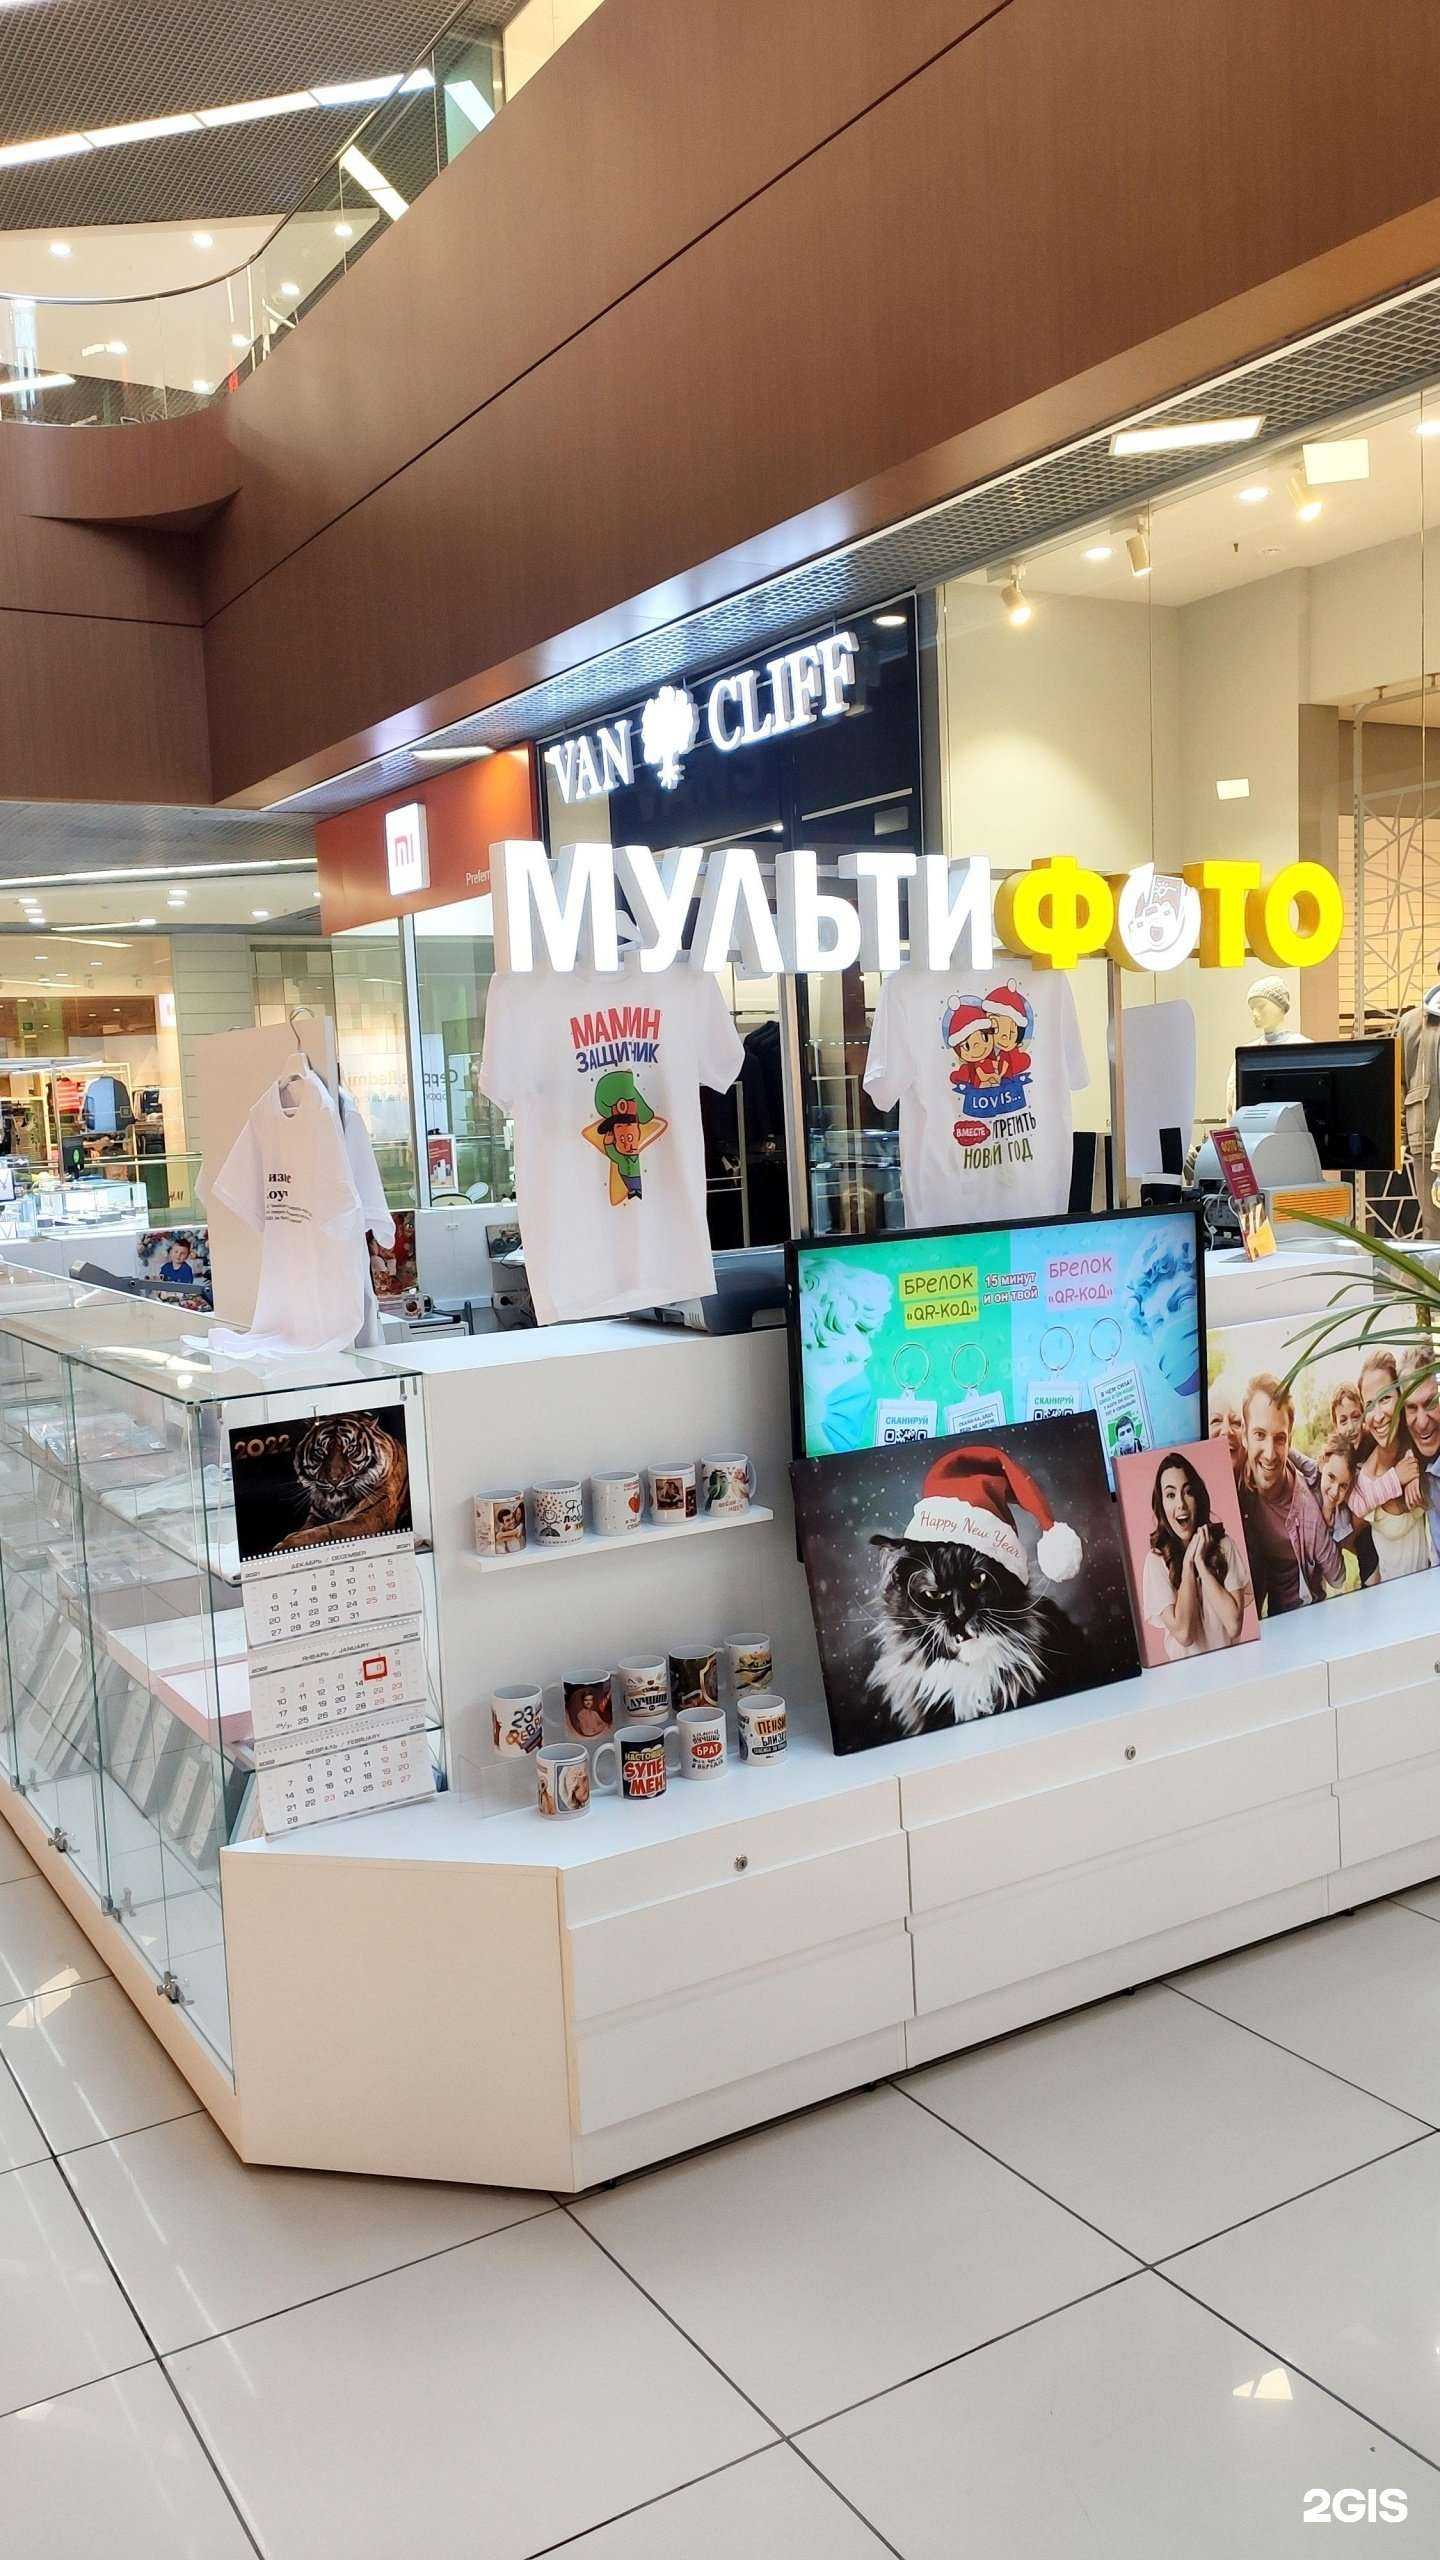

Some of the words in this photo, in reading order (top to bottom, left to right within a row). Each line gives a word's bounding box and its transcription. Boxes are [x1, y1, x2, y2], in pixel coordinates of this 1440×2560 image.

[545, 719, 635, 803] VAN
[708, 631, 860, 751] CLIFF
[570, 1006, 661, 1050] МАМИН
[972, 1096, 998, 1109] LOV
[956, 1127, 986, 1138] ВМЕСТЕ
[1007, 1137, 1033, 1163] ГОД
[985, 1276, 998, 1288] 15
[1000, 1272, 1037, 1288] минут
[983, 1294, 992, 1305] и
[994, 1292, 1009, 1303] он
[1010, 1288, 1039, 1302] твой
[1034, 1395, 1074, 1405] СКАНИРУЙ
[885, 1415, 929, 1426] СКАНИРУЙ
[234, 1434, 290, 1460] 2022
[920, 1510, 958, 1533] Happy
[963, 1516, 990, 1537] New
[993, 1530, 1021, 1558] Year
[291, 1559, 322, 1570] ДЕКАБРЬ
[331, 1550, 367, 1562] DECEMBER
[269, 1617, 281, 1625] 20
[328, 1604, 339, 1612] 23
[366, 1597, 378, 1605] 25
[386, 1593, 397, 1601] 26
[290, 1624, 301, 1632] 28
[309, 1620, 320, 1628] 29
[328, 1616, 340, 1624] 30
[336, 1684, 345, 1692] 13
[373, 1687, 384, 1695] 22
[298, 1717, 309, 1725] 25
[317, 1712, 328, 1720] 26
[511, 1705, 534, 1728] 23
[347, 1733, 381, 1745] FEBRUARY
[696, 1743, 719, 1757] БРАТ
[325, 1782, 334, 1790] 16
[362, 1785, 374, 1793] 25
[382, 1780, 392, 1788] 26
[401, 1775, 411, 1783] 27
[287, 1816, 298, 1824] 28
